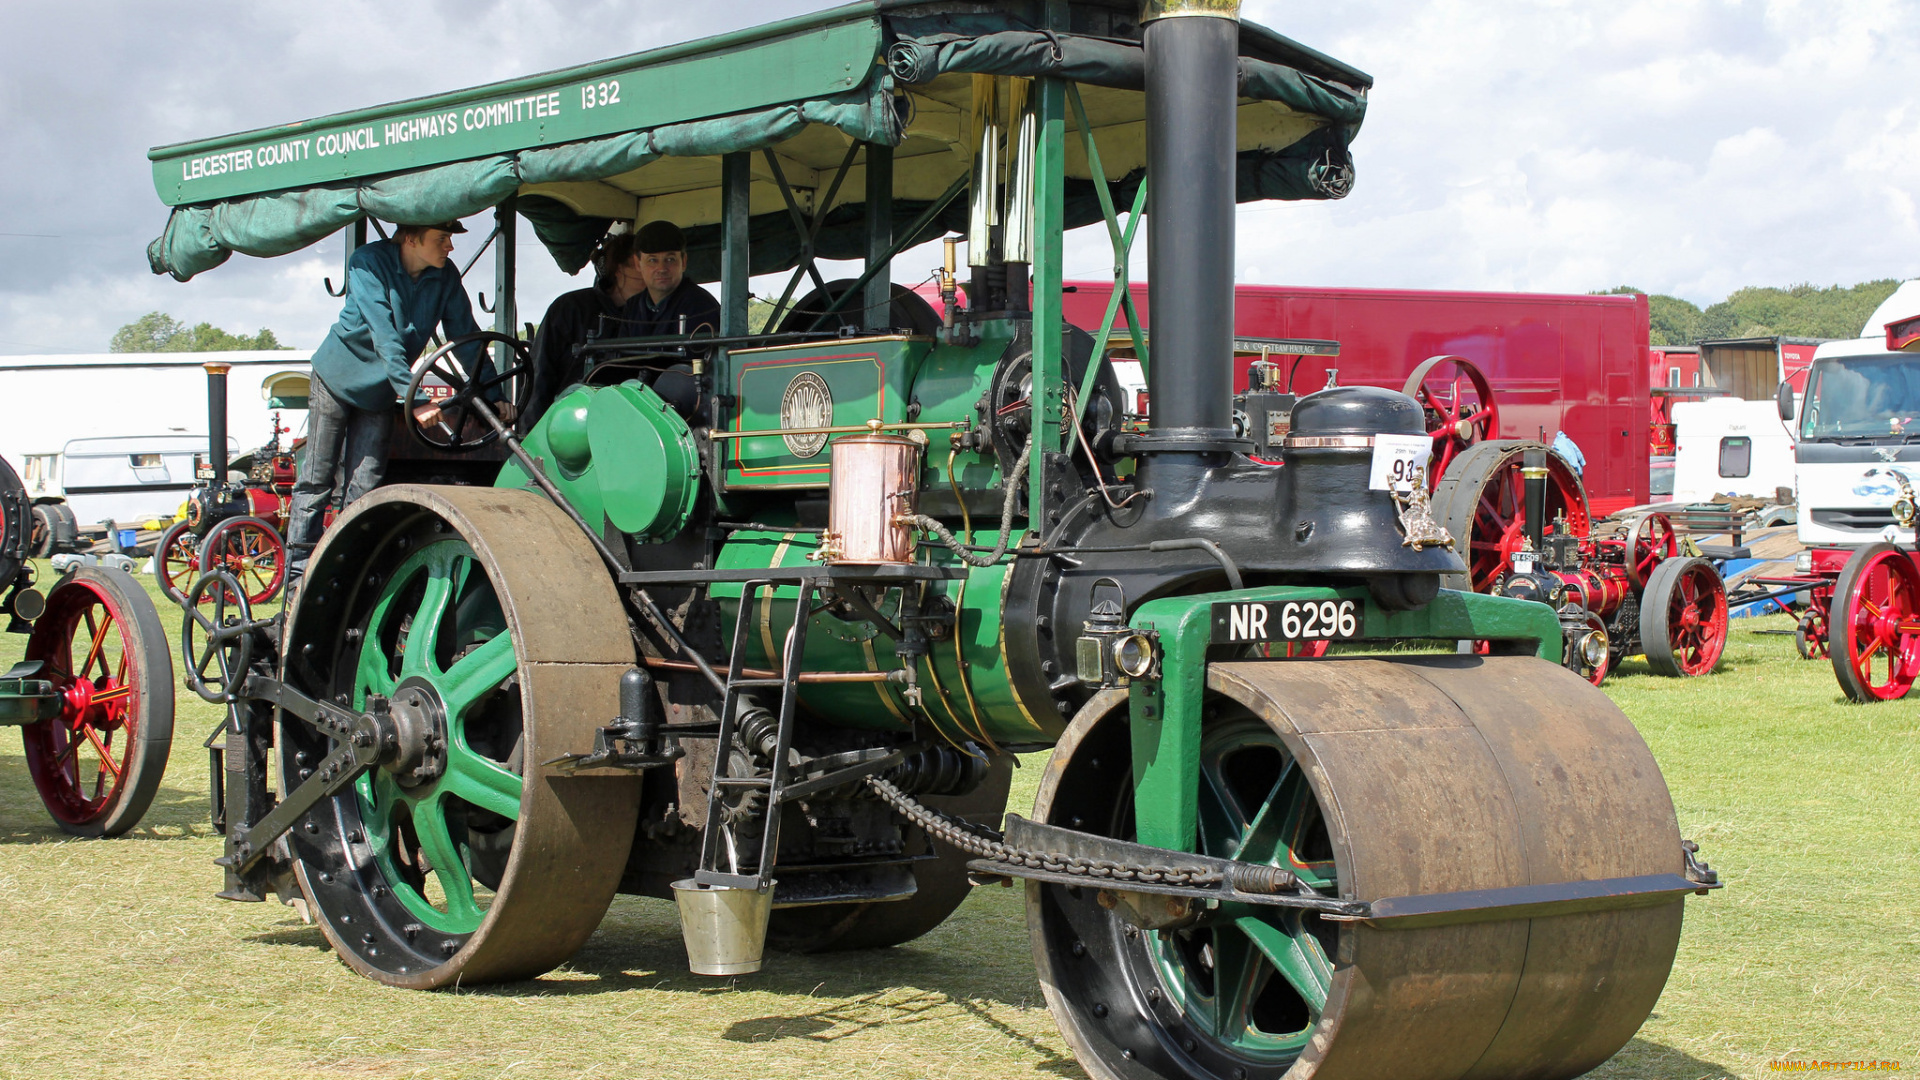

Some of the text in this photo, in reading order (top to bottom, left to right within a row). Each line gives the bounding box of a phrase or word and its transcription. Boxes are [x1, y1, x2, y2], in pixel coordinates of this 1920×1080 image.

[183, 80, 621, 181] LEICESTER COUNTY COUNCIL HIGHWAYS COMMITTEE 1332
[1289, 344, 1315, 354] HAULAGE
[1784, 352, 1801, 360] TOYOTA
[1393, 459, 1414, 482] 93
[1229, 600, 1356, 640] NR 6296
